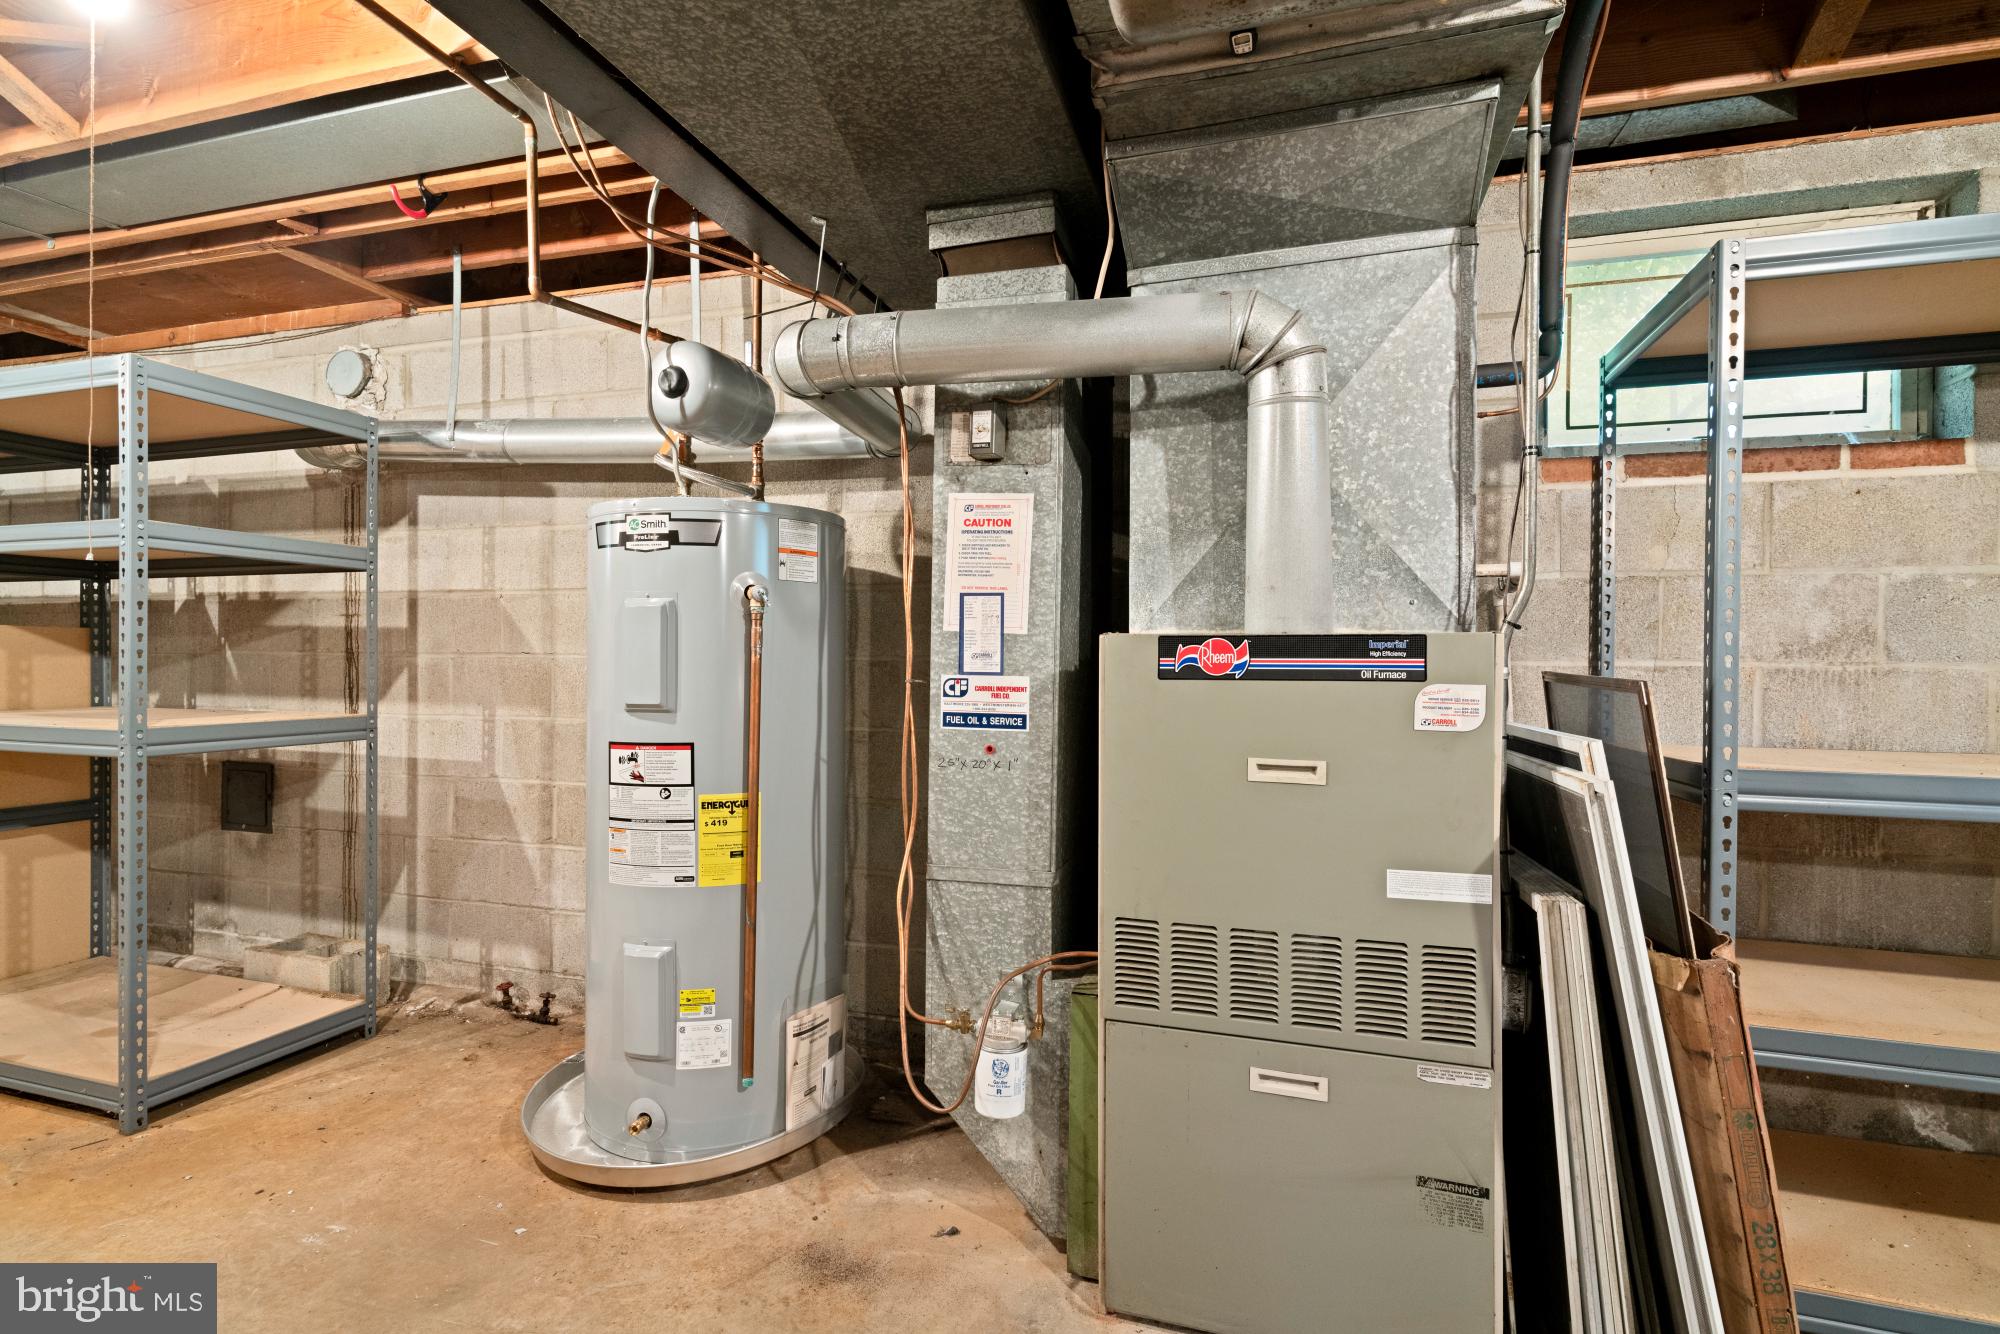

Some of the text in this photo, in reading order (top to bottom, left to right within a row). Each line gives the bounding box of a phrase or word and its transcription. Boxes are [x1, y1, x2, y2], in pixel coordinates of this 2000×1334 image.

[640, 519, 667, 529] Smith
[963, 519, 1012, 527] CAUTION
[1368, 639, 1407, 649] Imperial
[1201, 639, 1235, 668] Rheem
[1361, 670, 1407, 679] Oil Furnace
[946, 715, 1023, 726] FUEL OIL & SERVICE
[701, 799, 748, 810] ENERGYGUI
[710, 819, 728, 827] 419
[1434, 1181, 1480, 1196] WARNING
[1752, 1221, 1777, 1250] 28
[1760, 1268, 1785, 1295] 38
